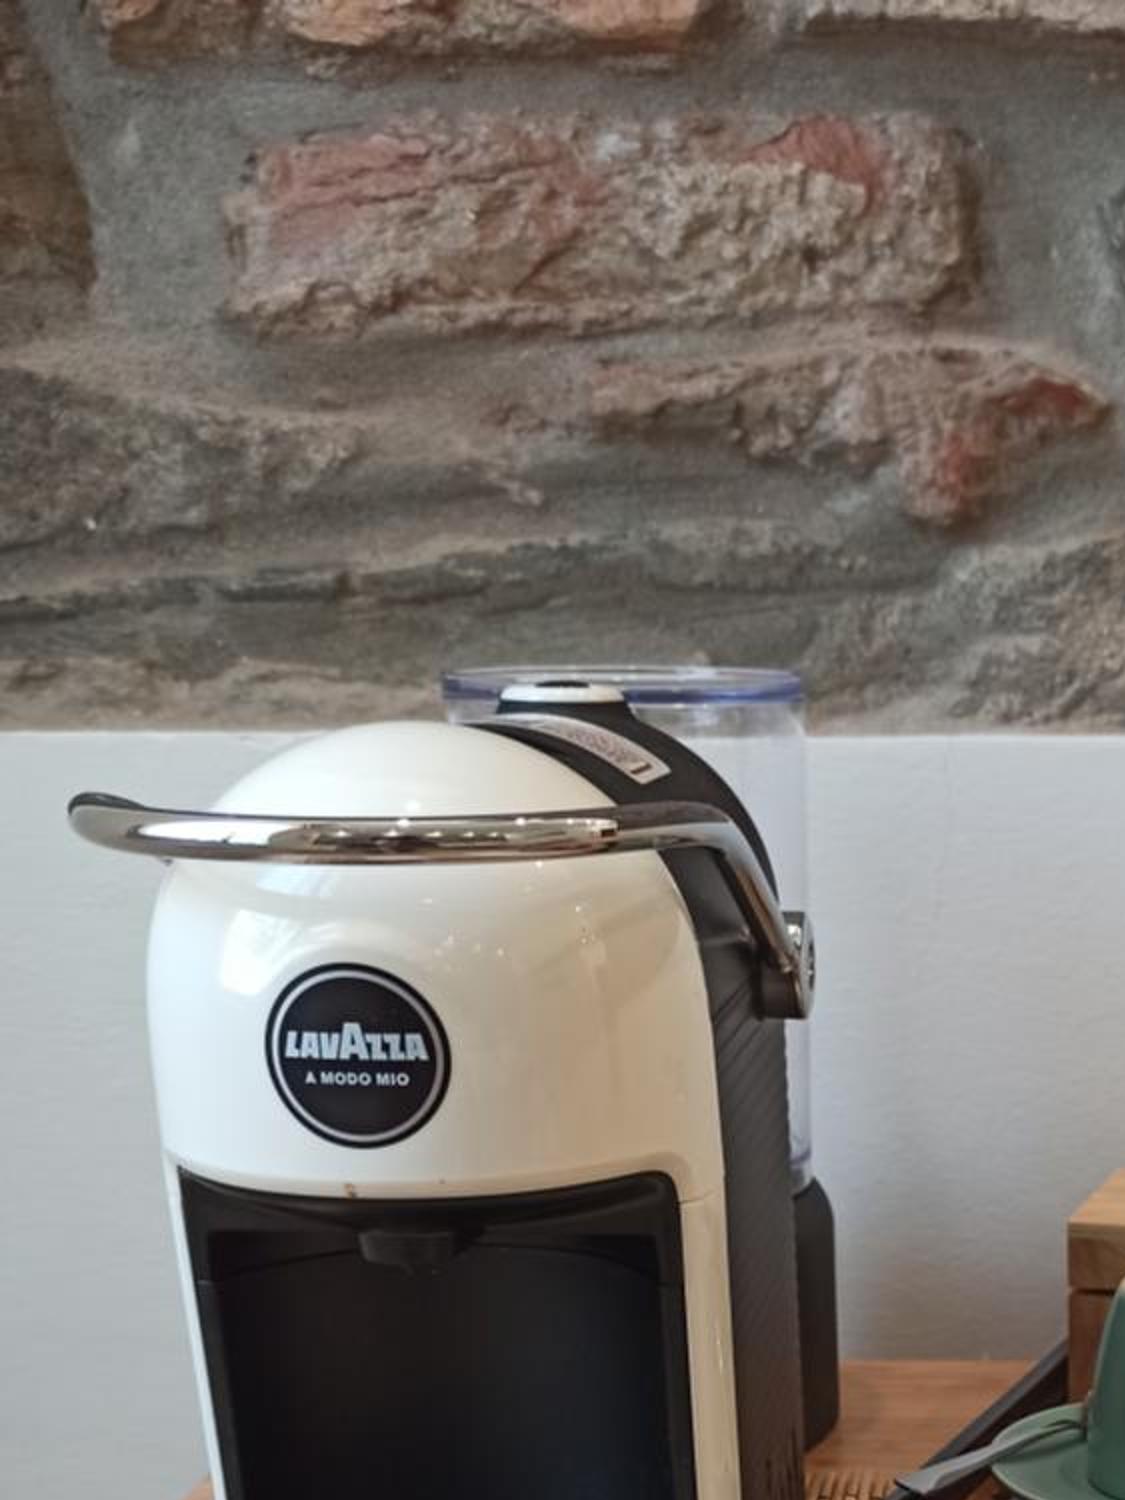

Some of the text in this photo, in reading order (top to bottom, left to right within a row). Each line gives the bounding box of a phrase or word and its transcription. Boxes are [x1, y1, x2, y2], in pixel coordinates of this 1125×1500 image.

[285, 1022, 429, 1061] LAVAZZA
[305, 1071, 410, 1086] A MODO MIO
